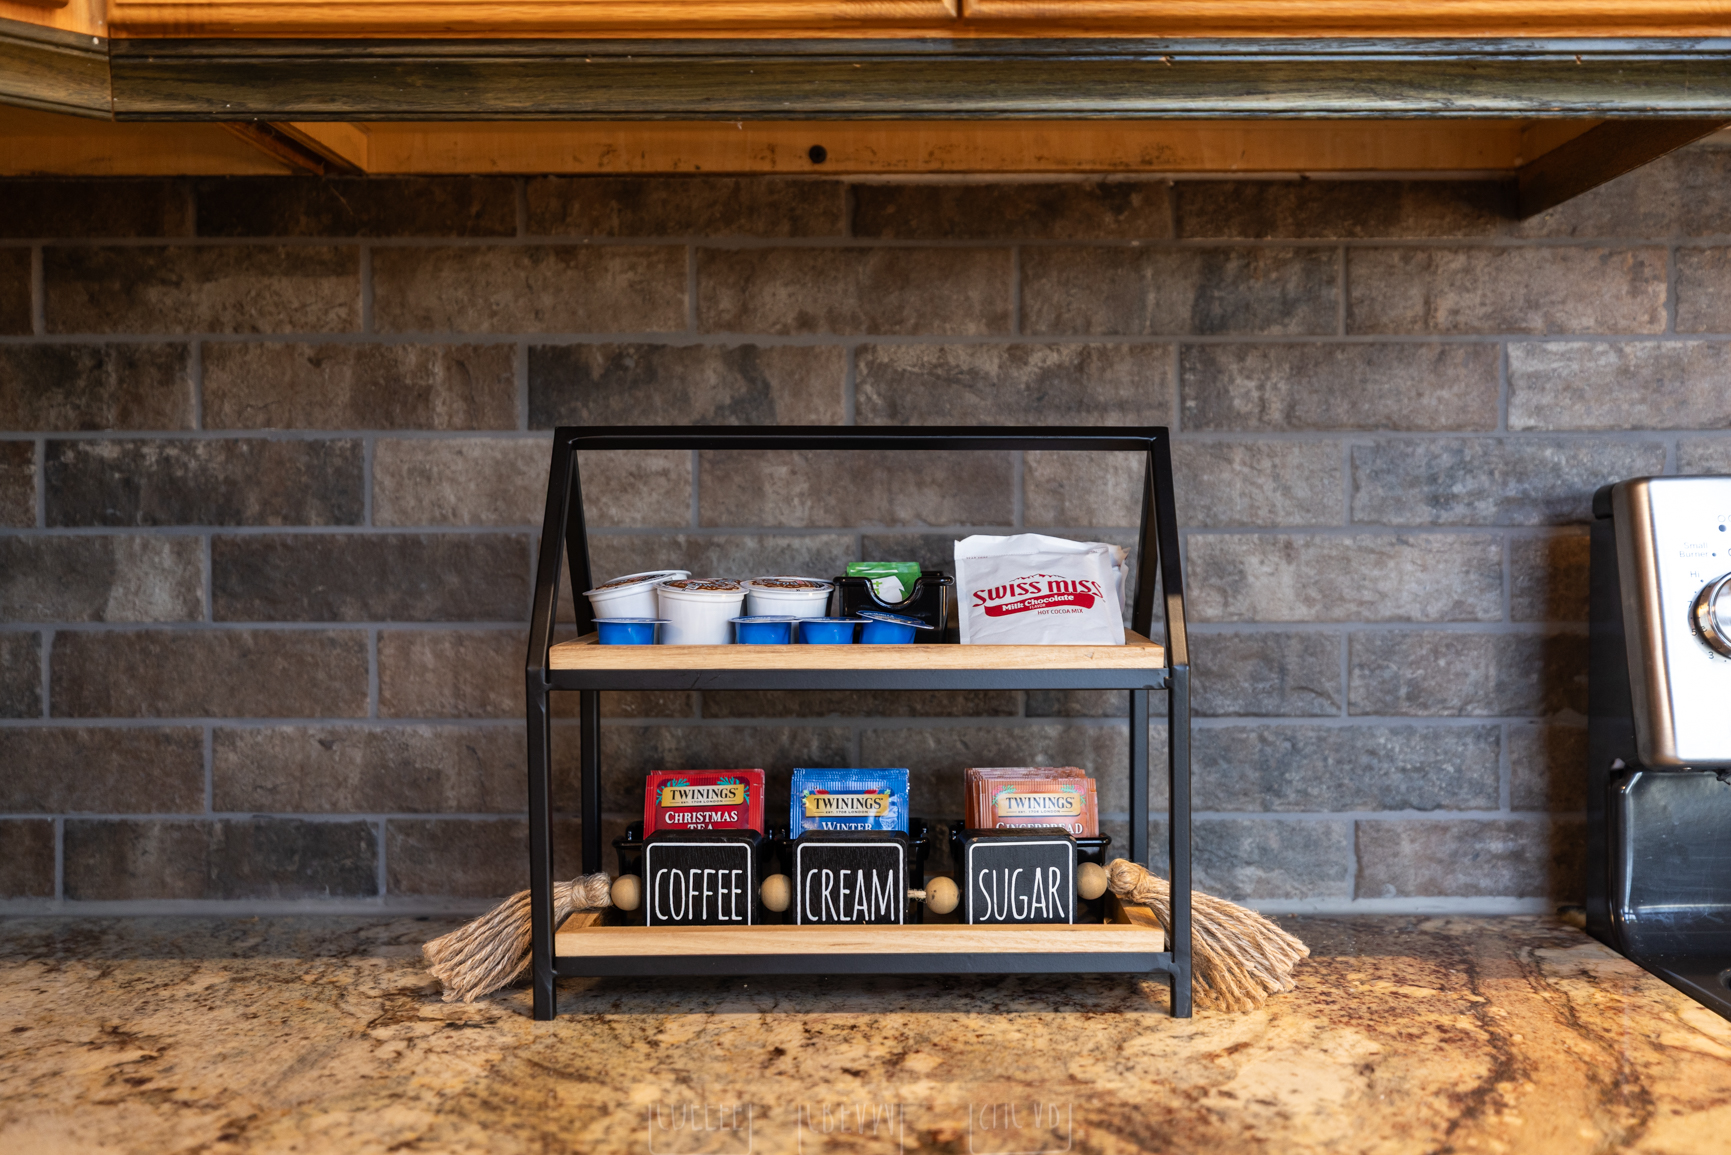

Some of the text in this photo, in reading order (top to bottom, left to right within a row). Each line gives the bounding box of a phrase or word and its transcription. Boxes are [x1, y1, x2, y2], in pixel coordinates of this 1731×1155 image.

[1684, 541, 1708, 549] Small
[1679, 550, 1708, 558] Burner
[972, 581, 1042, 608] SWISS
[1002, 594, 1075, 612] Milk Chocolate
[670, 787, 737, 801] TWININGS
[813, 797, 883, 810] TWININGS
[1005, 796, 1073, 810] TWININGS
[665, 811, 738, 824] CHRISTMAS
[655, 868, 743, 920] COFFEE
[805, 868, 895, 921] CREAM
[978, 867, 1065, 921] SUGAR
